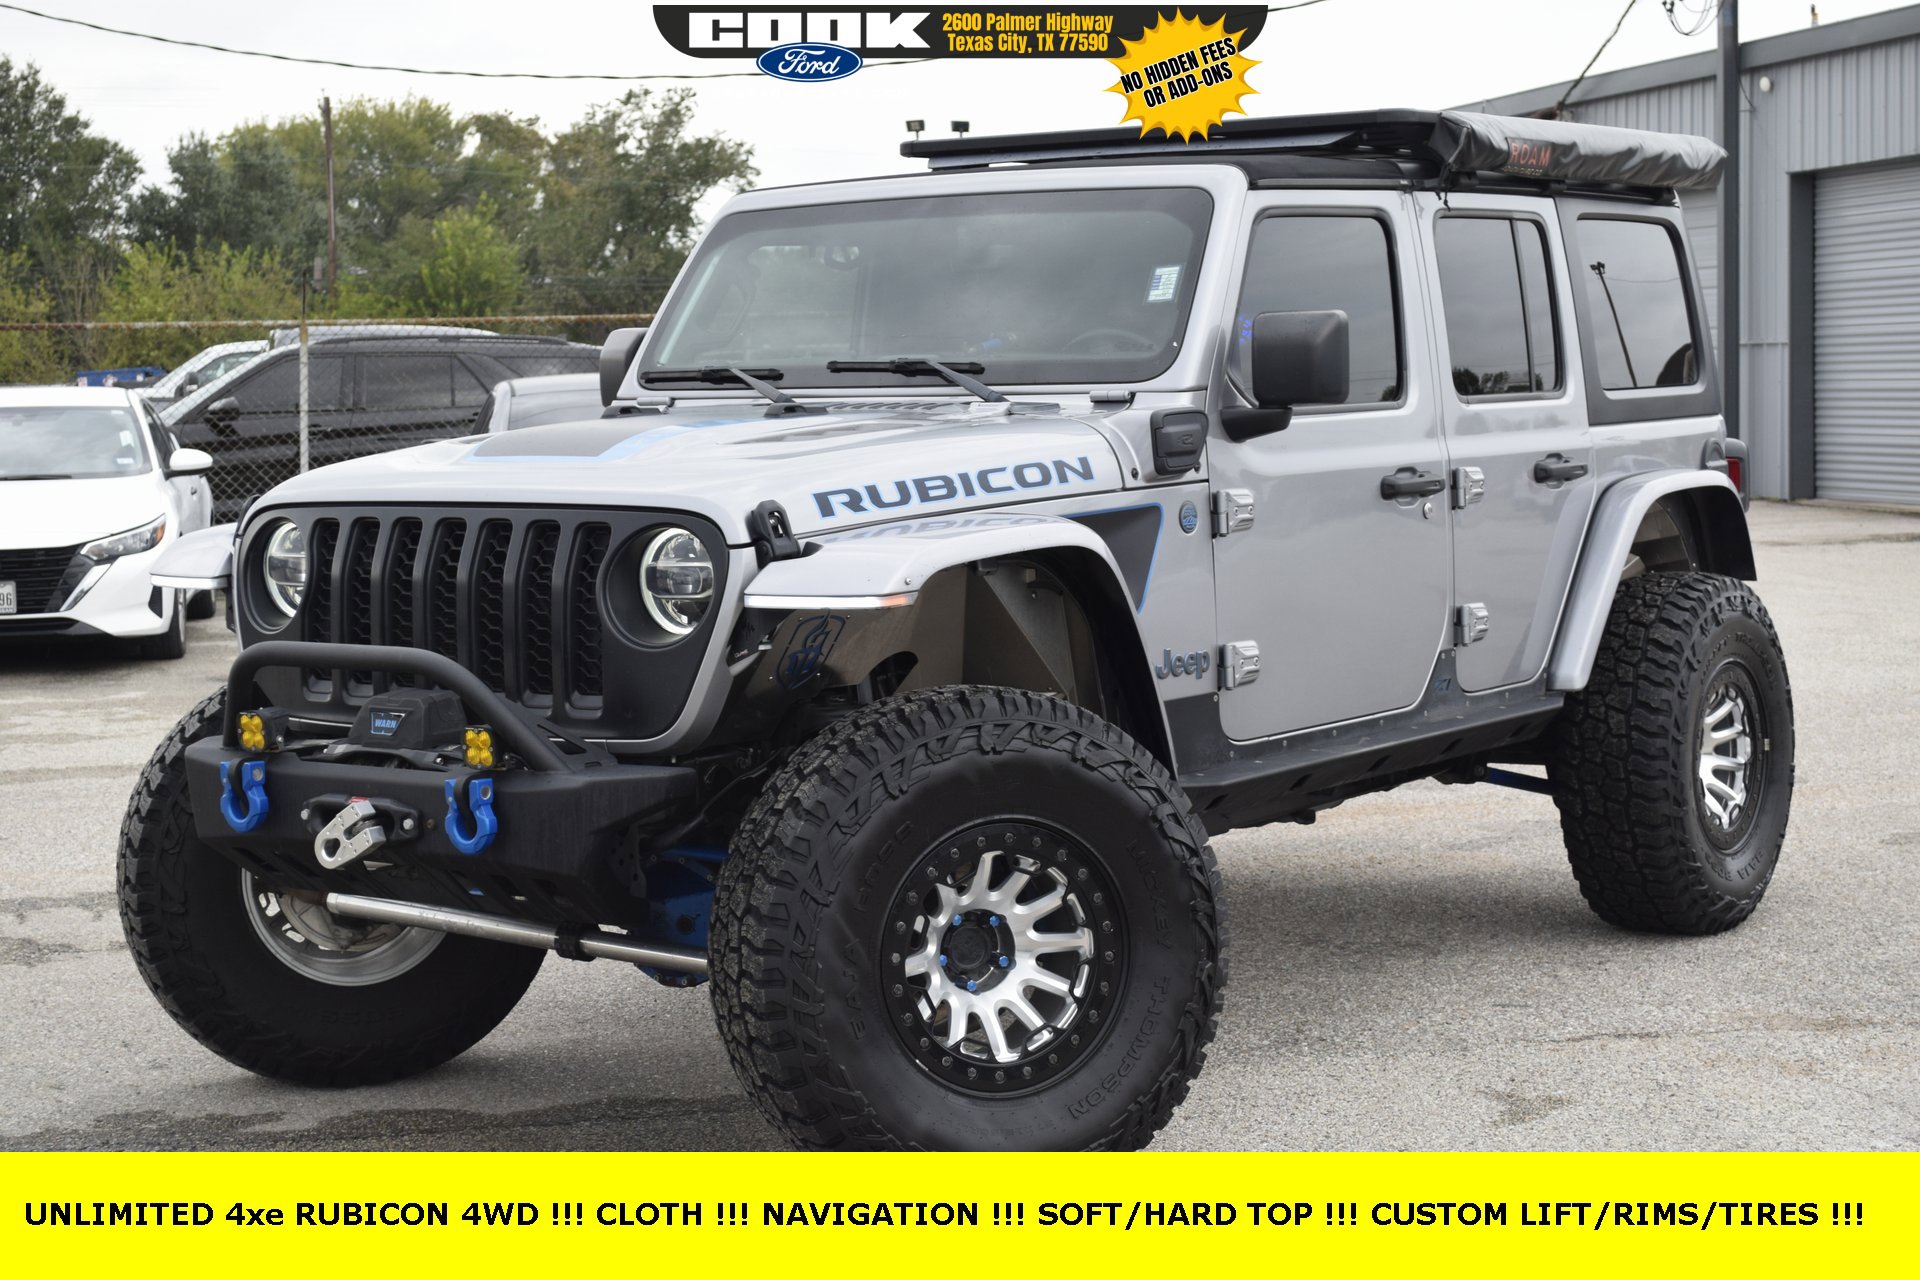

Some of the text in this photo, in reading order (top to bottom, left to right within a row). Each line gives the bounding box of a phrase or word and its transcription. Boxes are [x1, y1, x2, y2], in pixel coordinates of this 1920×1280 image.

[1510, 143, 1551, 167] ROAM
[812, 456, 1096, 519] RUBICON
[1155, 647, 1211, 680] Jeep
[375, 719, 397, 728] WARN
[1067, 975, 1171, 1122] THOMPSON
